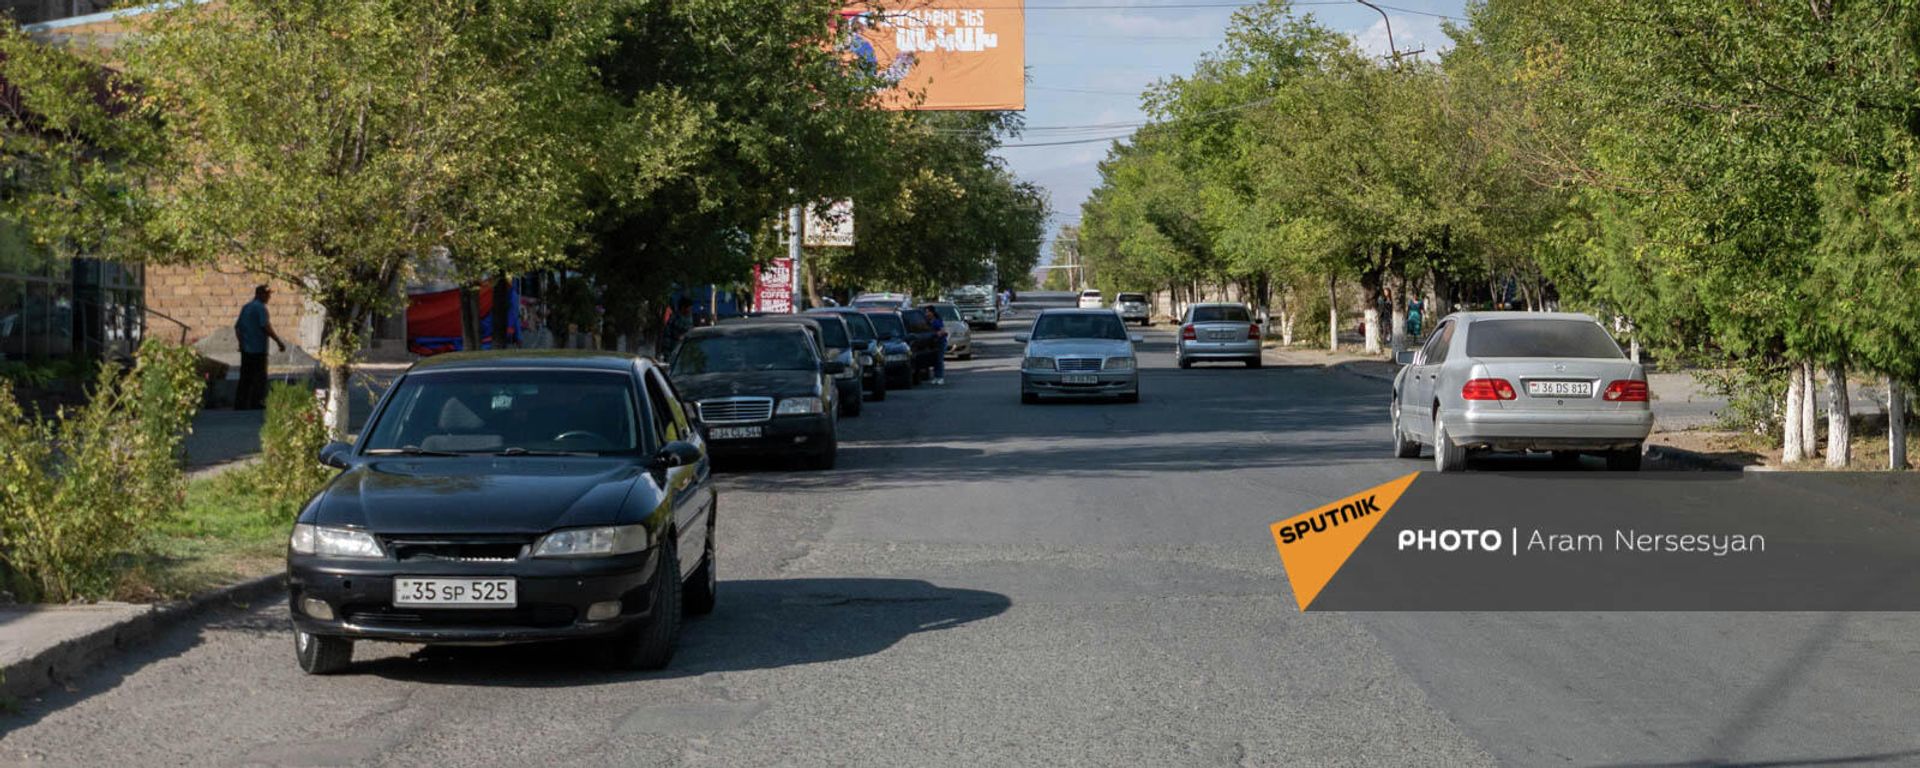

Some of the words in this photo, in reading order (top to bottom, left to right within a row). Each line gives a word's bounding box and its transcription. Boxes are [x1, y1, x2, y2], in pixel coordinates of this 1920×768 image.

[760, 291, 790, 299] COFFEE
[1542, 383, 1553, 393] 36
[1556, 383, 1569, 393] DS
[1571, 384, 1588, 394] 812
[412, 582, 437, 600] 35
[442, 586, 465, 600] SP
[471, 582, 508, 600] 525
